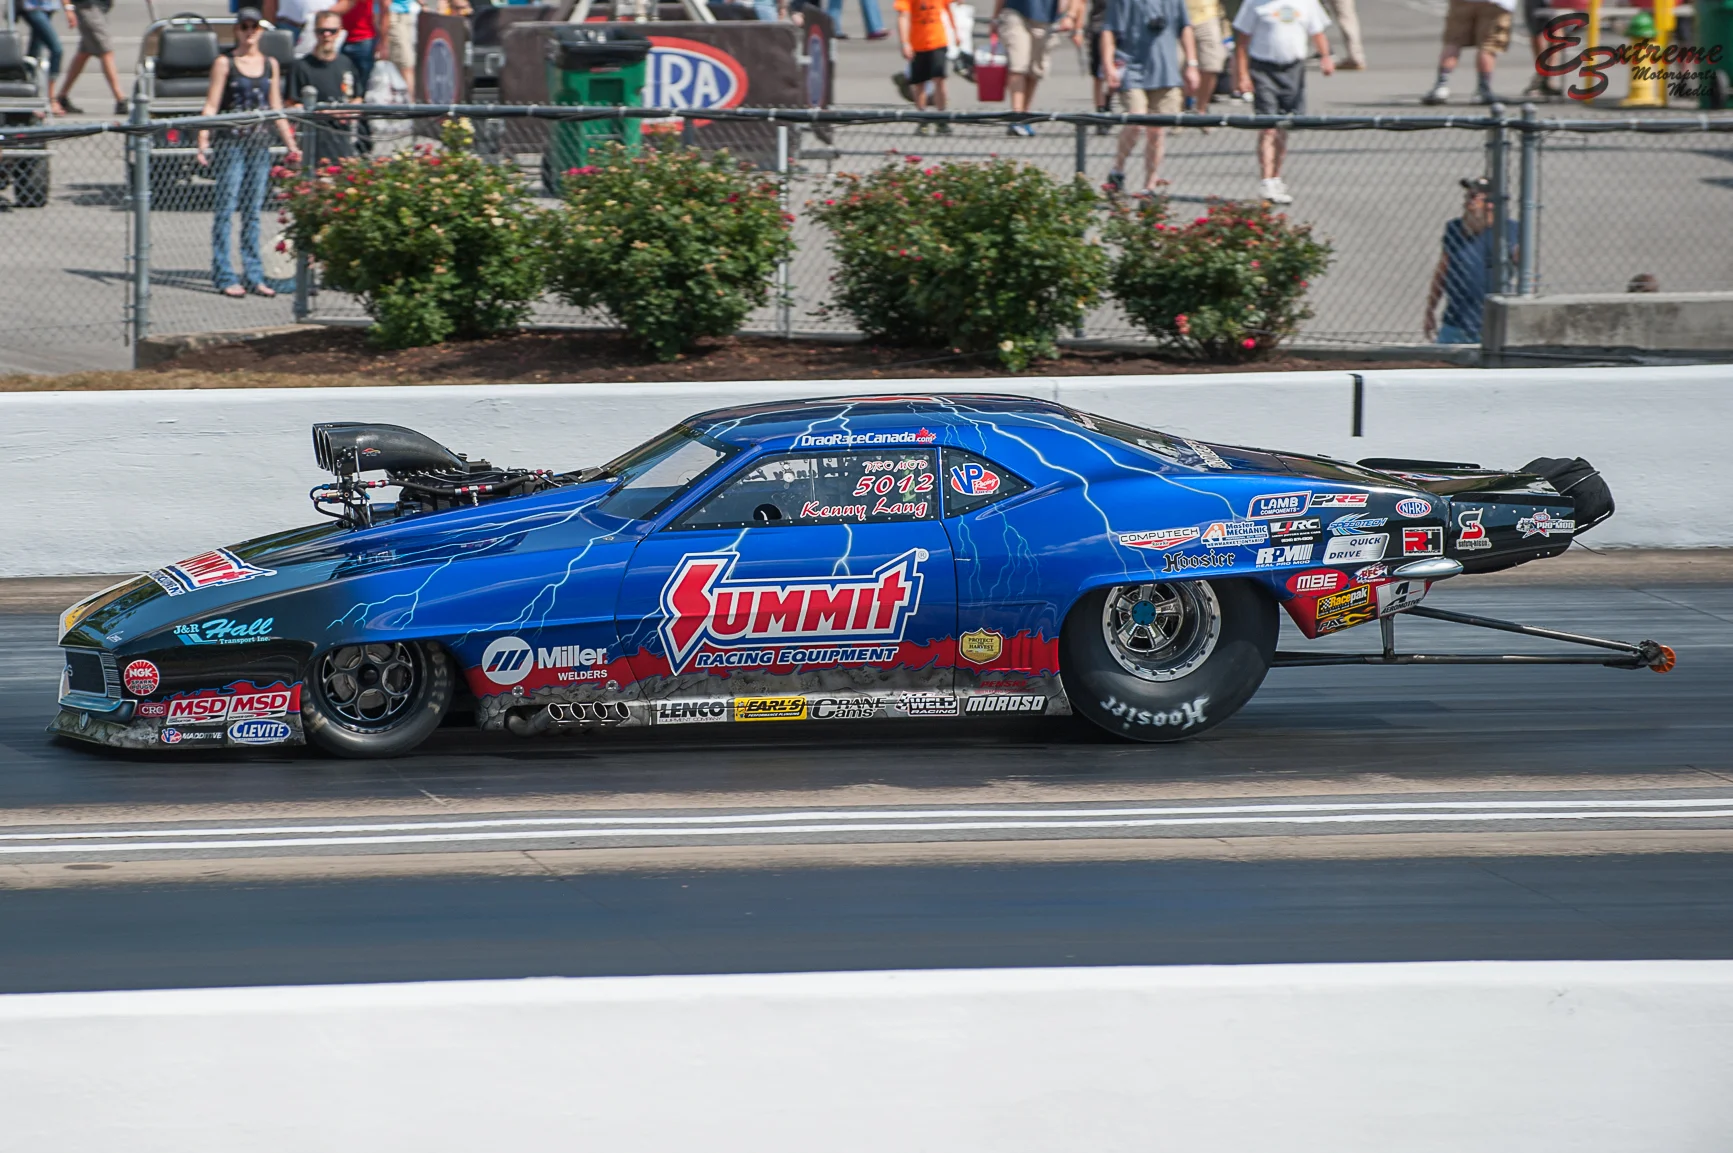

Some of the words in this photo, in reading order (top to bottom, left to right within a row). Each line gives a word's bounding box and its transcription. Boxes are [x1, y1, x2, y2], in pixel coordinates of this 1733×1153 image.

[862, 460, 894, 473] PRO
[895, 460, 928, 473] MOD
[853, 473, 934, 497] 5012
[950, 463, 984, 494] VP
[800, 501, 867, 521] Kenny
[872, 497, 928, 518] Lang
[1260, 497, 1299, 509] LAMB
[1400, 501, 1428, 514] NHRA
[1260, 507, 1298, 515] COMPONENTS
[1225, 522, 1254, 530] Master
[1226, 526, 1267, 536] MECHANIC
[1120, 528, 1199, 543] COMPUTECH
[1350, 537, 1382, 547] QUICK
[1161, 549, 1236, 573] Hoosier
[1256, 545, 1313, 565] RPM
[1329, 550, 1362, 559] DRIVE
[1297, 573, 1338, 588] MBE
[1330, 588, 1368, 606] Racepak
[1381, 598, 1422, 614] AEROMOTIVE
[173, 623, 200, 634] J&R
[202, 617, 275, 638] Hall
[219, 637, 255, 645] Transport
[696, 651, 773, 667] RACING
[777, 647, 898, 664] EQUIPMENT
[130, 667, 153, 678] NGK
[558, 670, 608, 681] WELDERS
[141, 706, 164, 714] CRC
[171, 698, 227, 717] MSD
[231, 694, 288, 713] MSD
[660, 701, 725, 718] LENCO
[747, 700, 801, 712] EARL'S
[911, 697, 957, 709] WELD
[966, 696, 1046, 711] MOROSO
[1100, 696, 1211, 730] Hoosier
[162, 728, 176, 743] VP
[232, 722, 285, 738] CLEVITE
